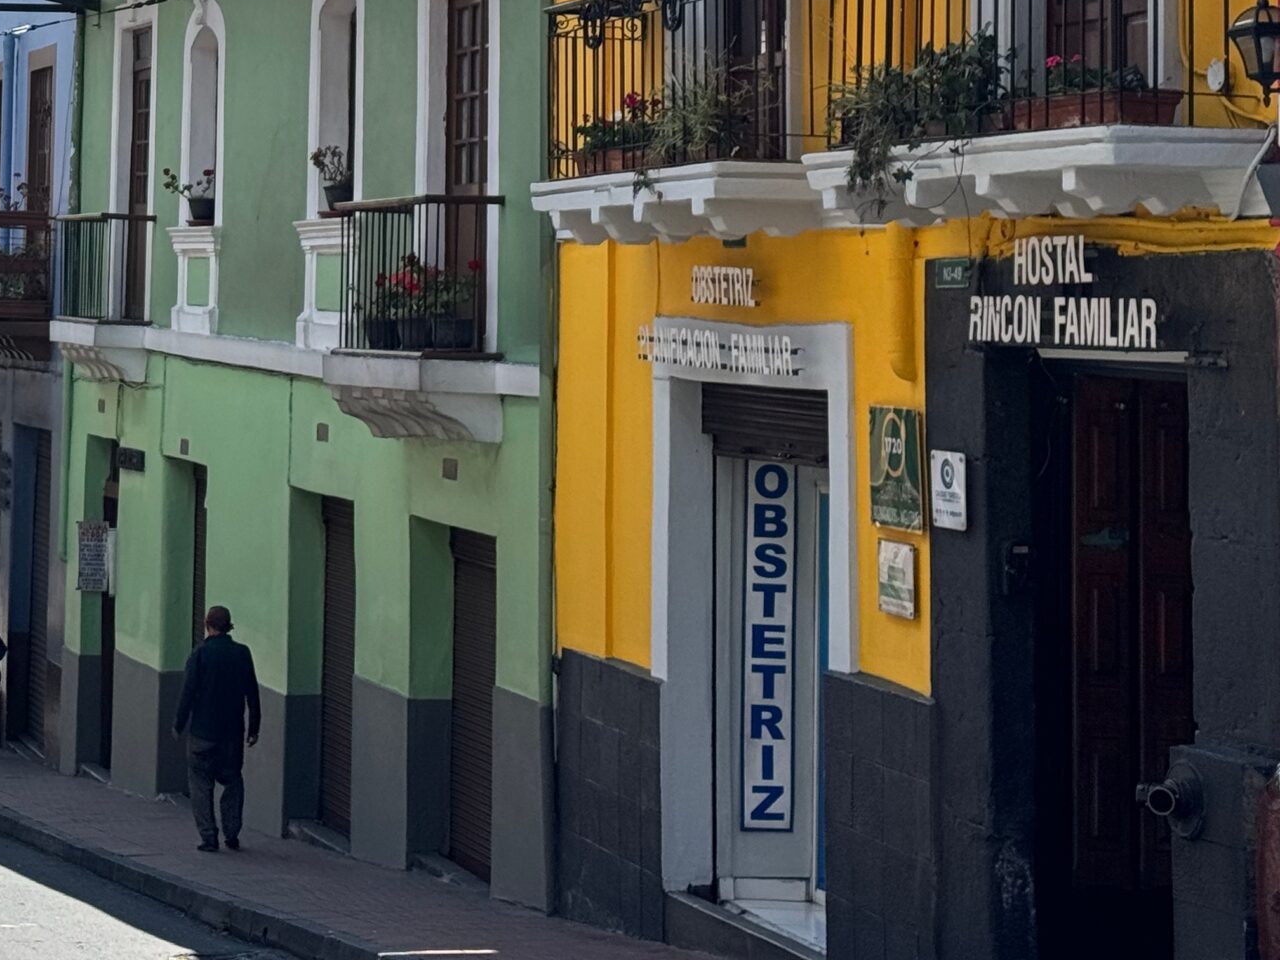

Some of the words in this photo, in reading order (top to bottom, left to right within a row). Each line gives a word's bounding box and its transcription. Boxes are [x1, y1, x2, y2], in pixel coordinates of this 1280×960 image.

[692, 265, 756, 307] OBSTETRIZ
[1014, 235, 1093, 285] HOSTAL
[969, 294, 1041, 344] RINCON
[1054, 296, 1157, 349] FAMILIAR
[638, 324, 721, 370] PLANIFICACION
[730, 333, 793, 377] FAMILIAR
[750, 463, 790, 821] OBSTETRIZ
